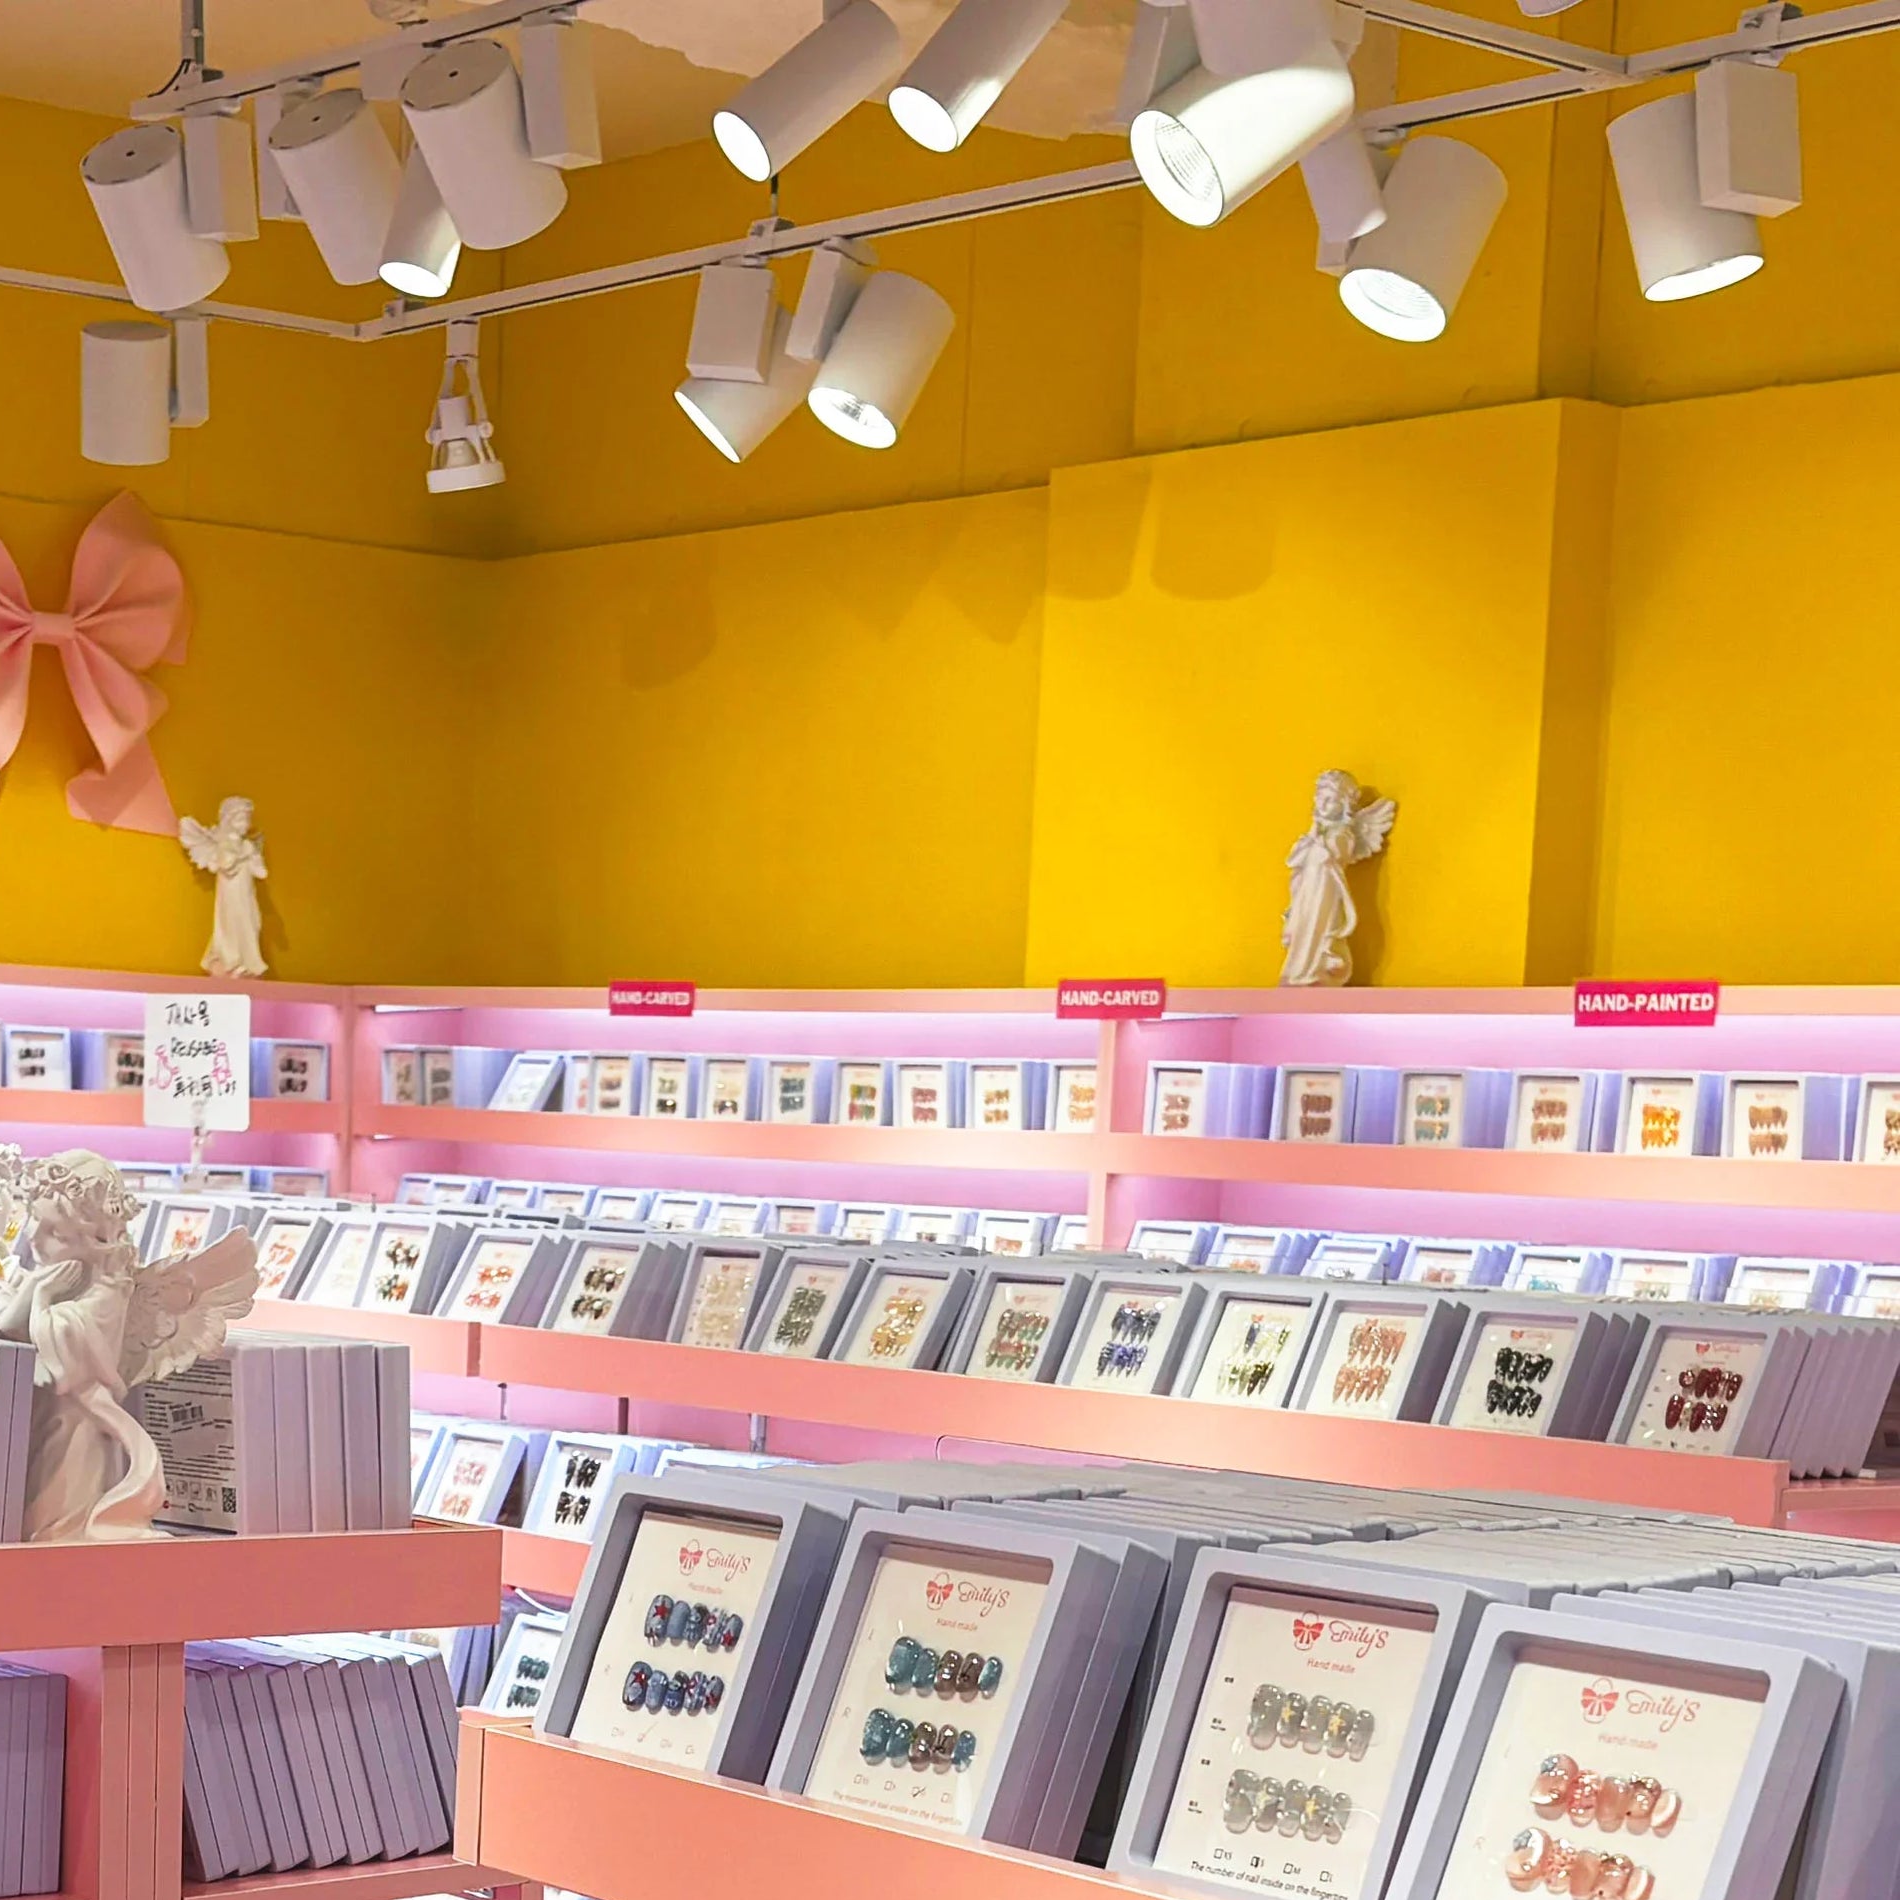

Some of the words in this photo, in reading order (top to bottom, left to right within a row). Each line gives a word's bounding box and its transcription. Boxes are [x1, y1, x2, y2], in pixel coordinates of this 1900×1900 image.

[1060, 989, 1161, 1007] HAND-CARVED
[1578, 992, 1715, 1012] HAND-PAINTED
[1191, 1860, 1204, 1873] The
[1205, 1866, 1235, 1879] number
[1235, 1871, 1246, 1881] of
[1245, 1874, 1260, 1884] nail
[1260, 1877, 1284, 1890] inside
[1284, 1883, 1295, 1892] on
[1296, 1884, 1310, 1896] the
